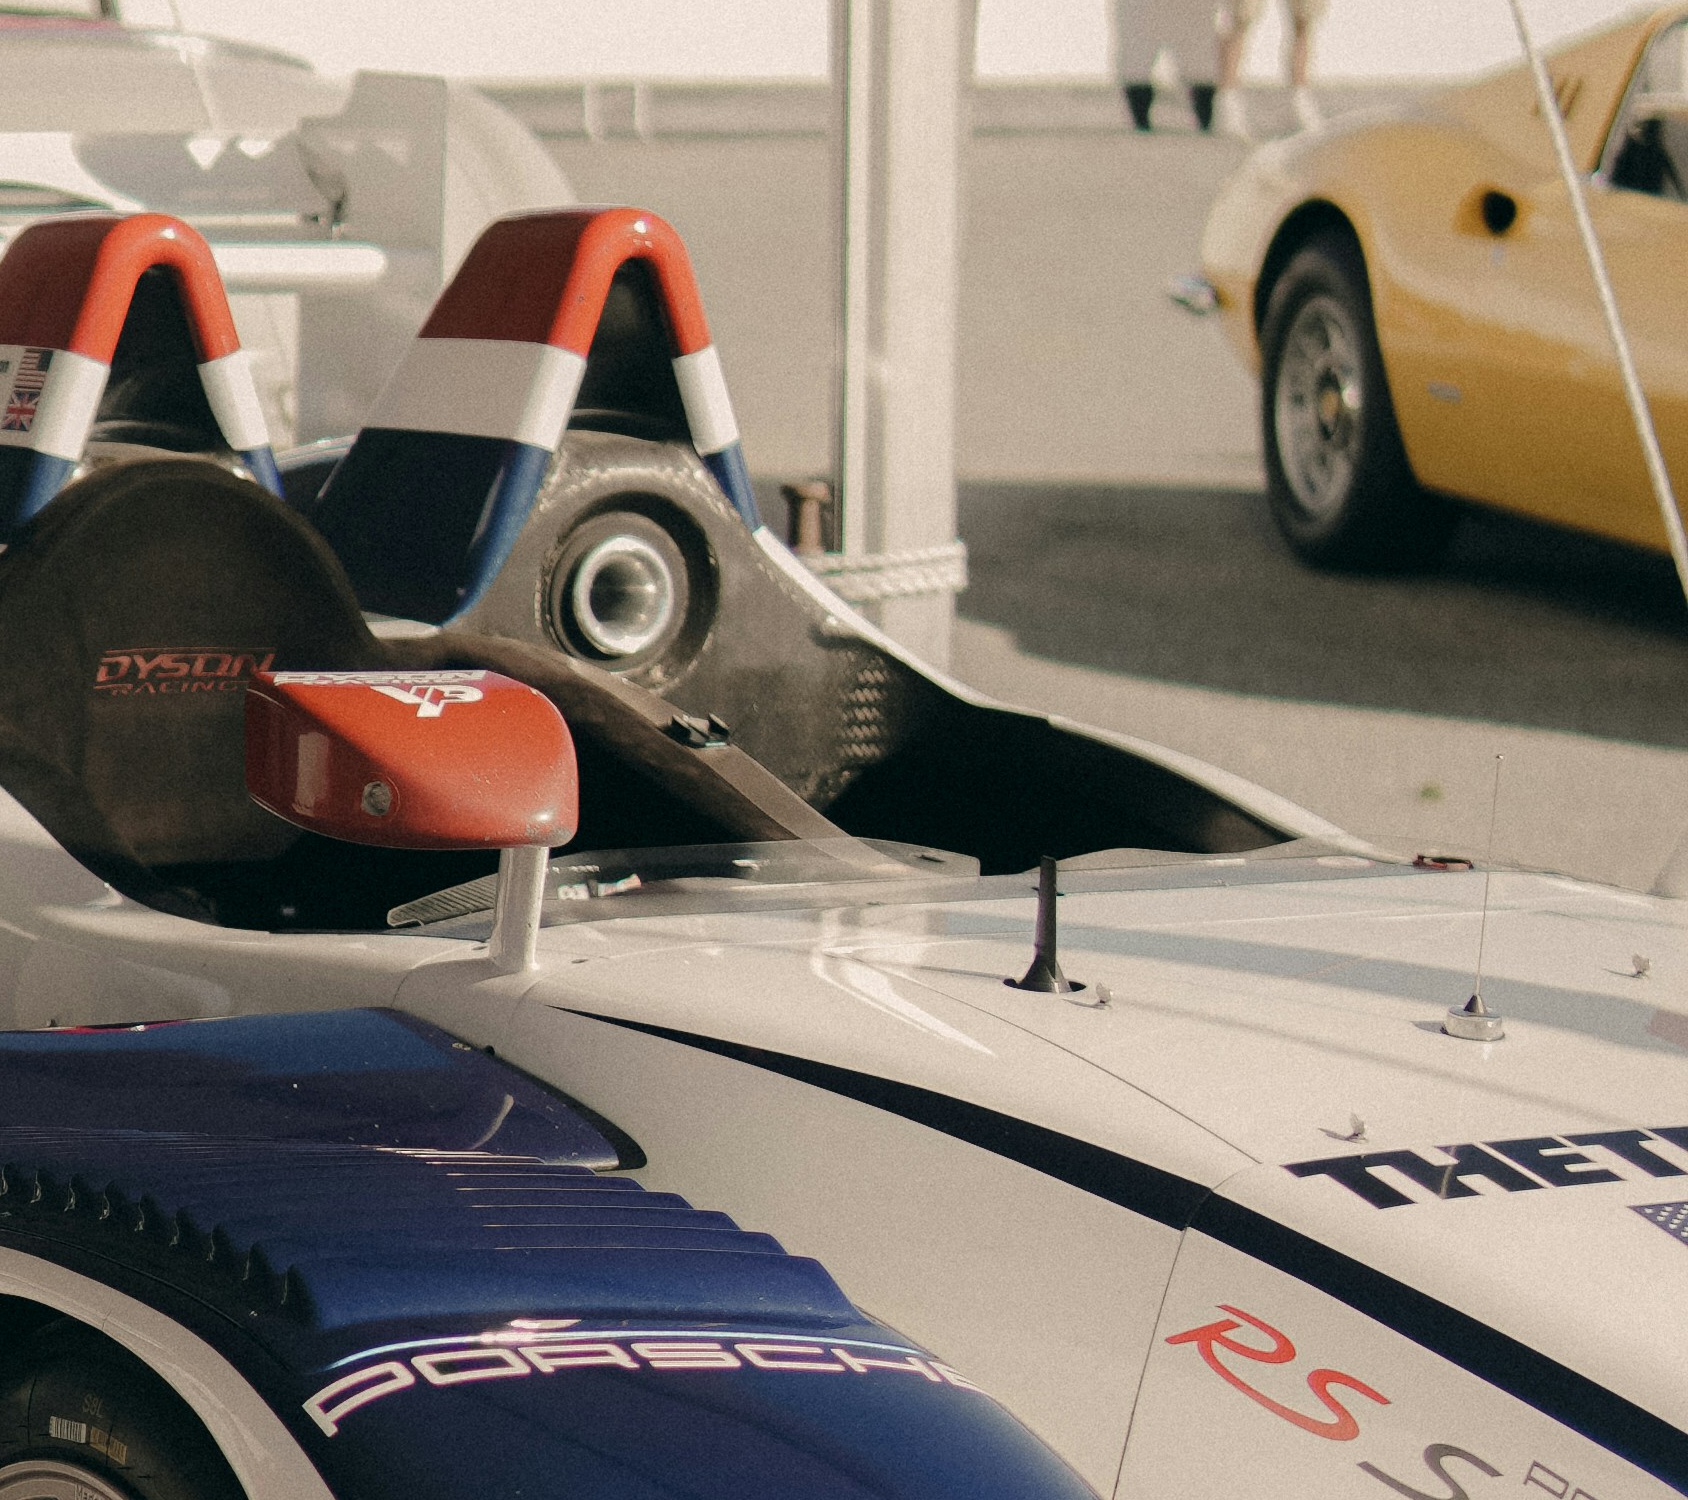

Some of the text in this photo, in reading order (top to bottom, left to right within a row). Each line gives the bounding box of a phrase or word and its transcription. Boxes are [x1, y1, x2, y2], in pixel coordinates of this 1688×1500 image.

[96, 652, 277, 684] DYSON
[302, 1341, 992, 1438] PORSCHE
[1164, 1303, 1393, 1443] RS
